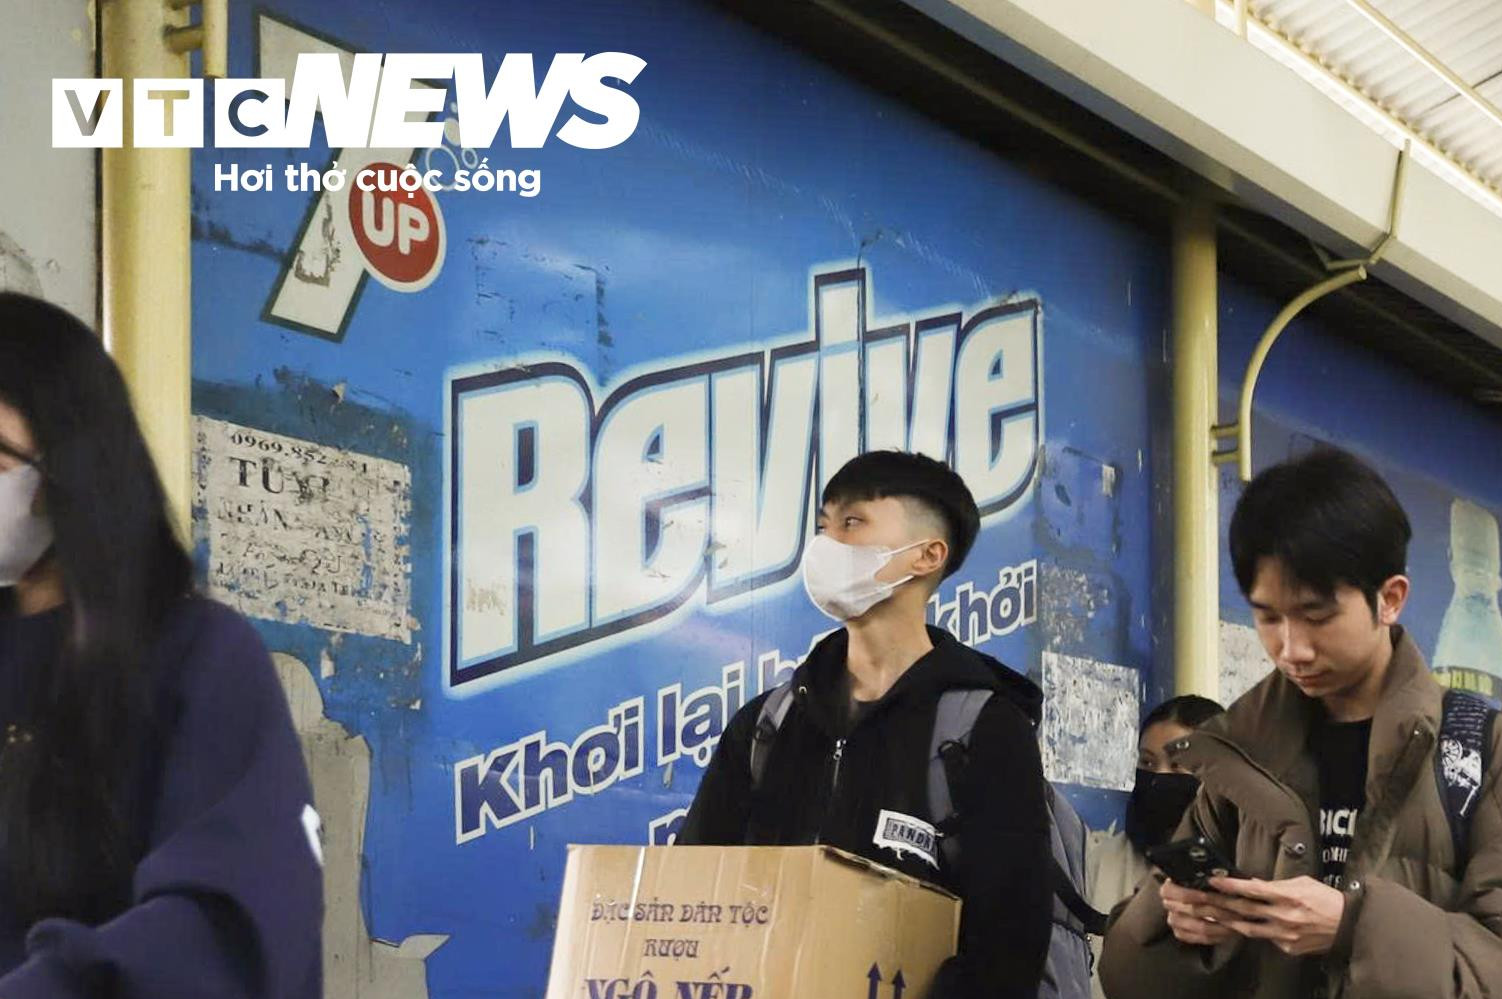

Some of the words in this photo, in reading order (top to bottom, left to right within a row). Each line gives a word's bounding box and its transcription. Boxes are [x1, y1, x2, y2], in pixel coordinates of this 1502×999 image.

[361, 192, 431, 255] UP
[450, 268, 1042, 688] Revive
[456, 692, 644, 844] Khơi
